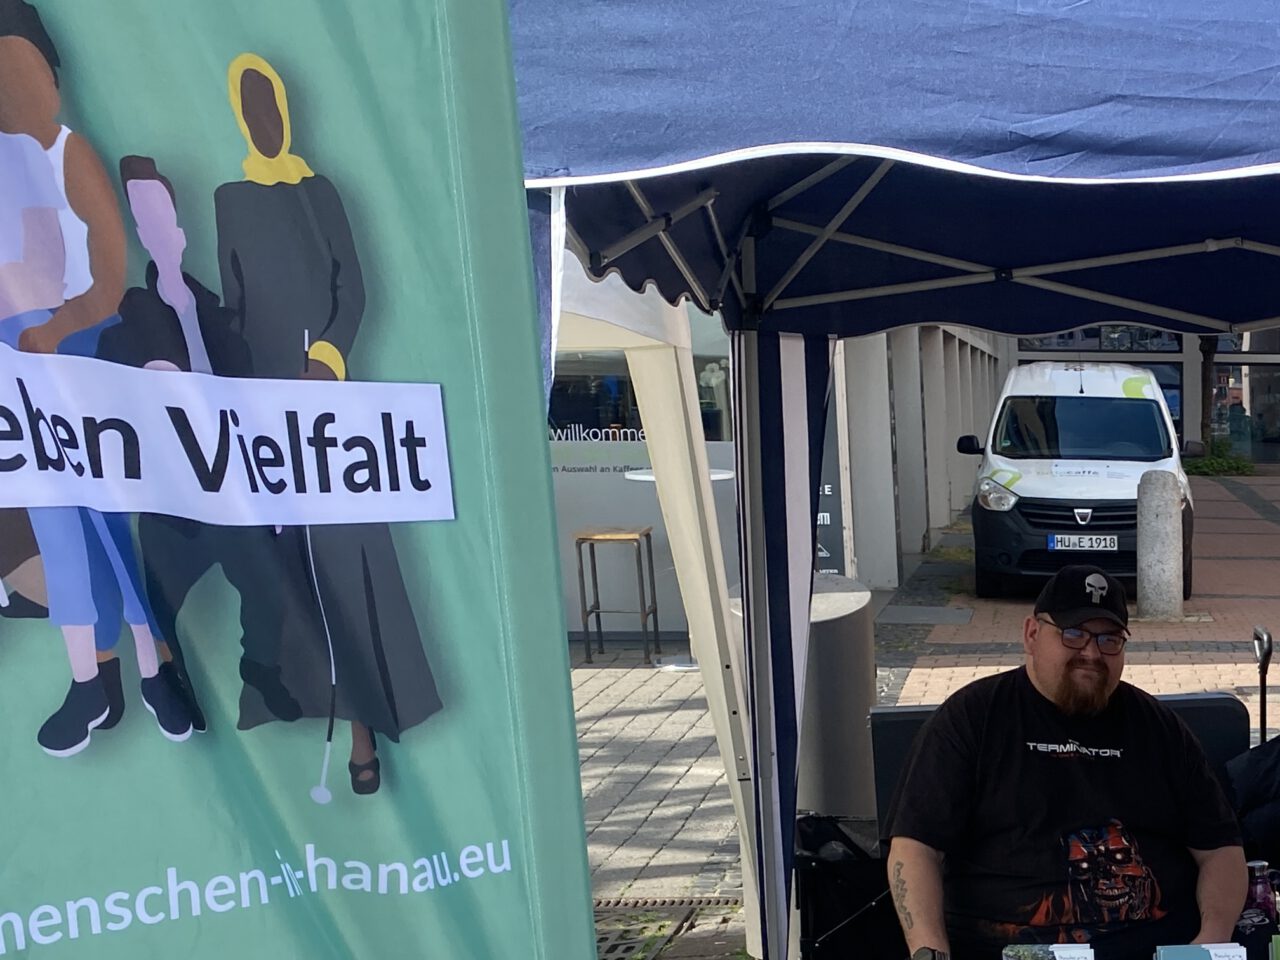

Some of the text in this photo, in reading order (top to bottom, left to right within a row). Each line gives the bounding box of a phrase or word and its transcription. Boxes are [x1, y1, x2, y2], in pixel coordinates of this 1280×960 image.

[165, 406, 432, 495] Vielfalt
[1056, 537, 1116, 549] HU E 1918
[1026, 739, 1123, 758] TERMINATOR
